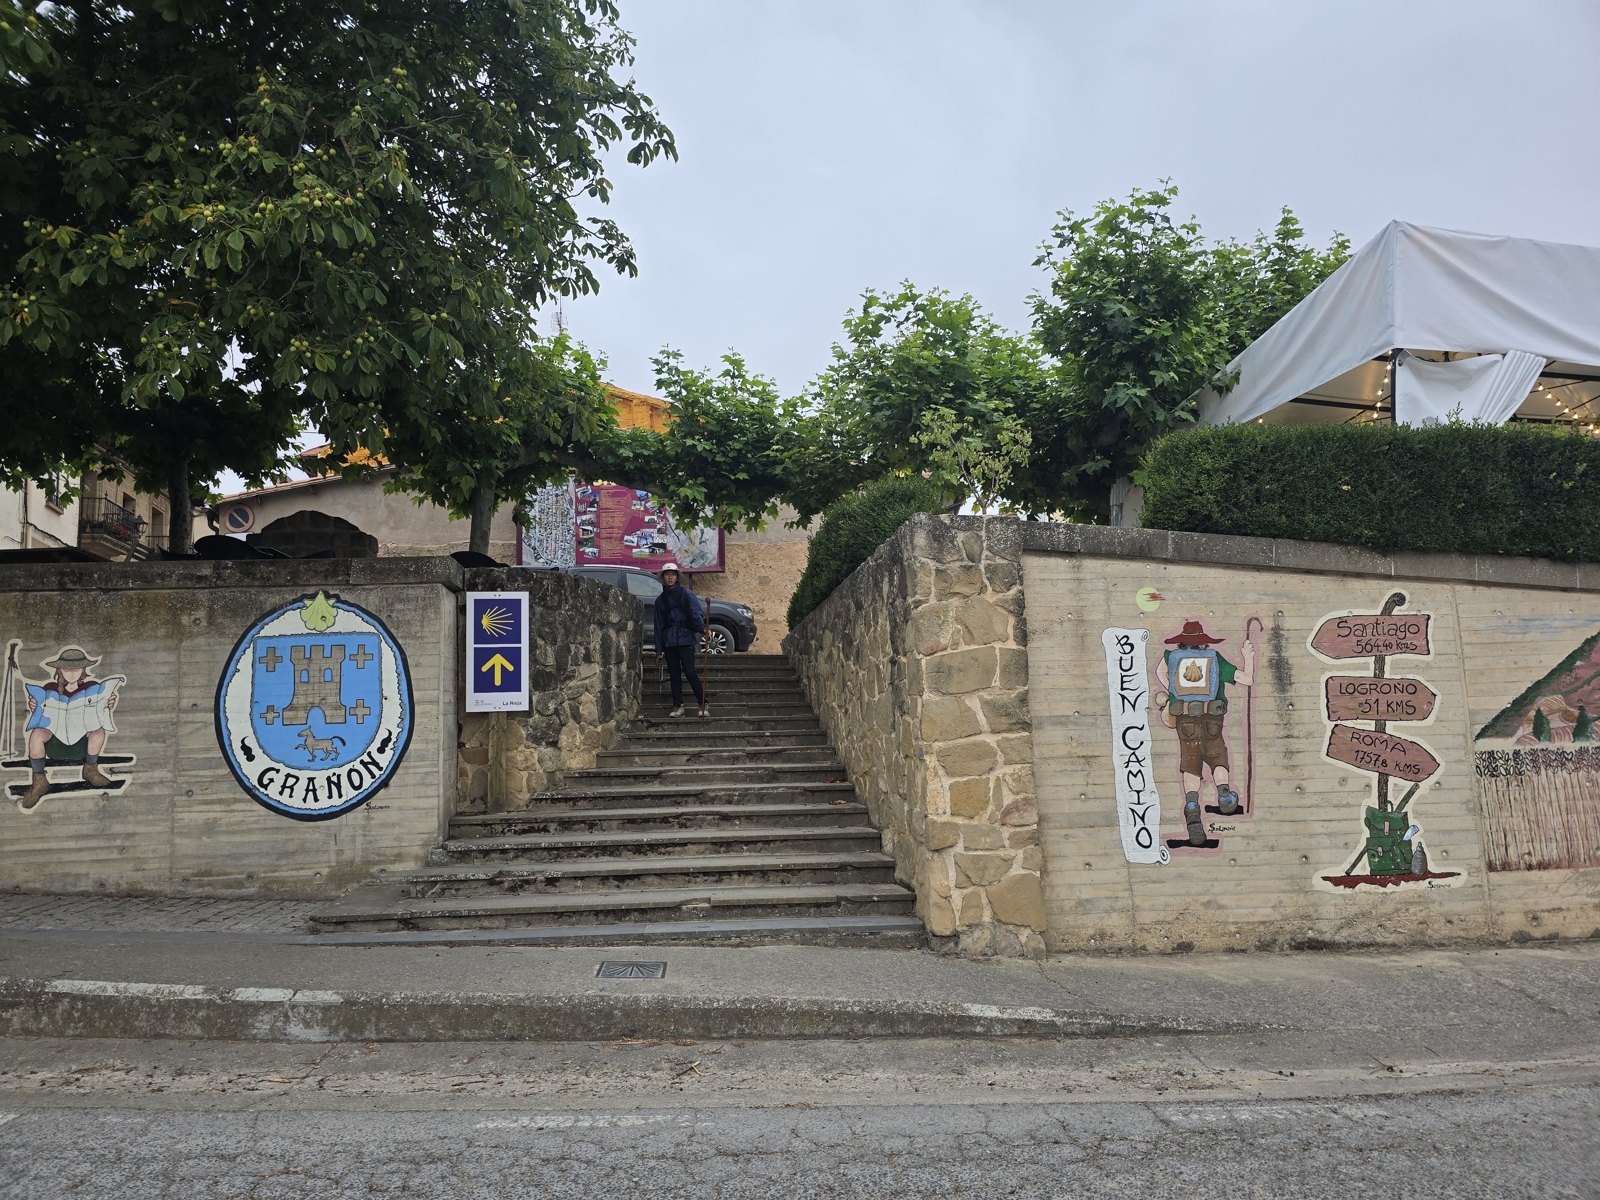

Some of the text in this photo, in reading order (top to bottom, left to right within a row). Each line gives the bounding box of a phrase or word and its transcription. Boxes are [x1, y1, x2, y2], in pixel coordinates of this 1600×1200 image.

[1336, 618, 1420, 640] Santiago
[1339, 680, 1418, 696] LOGROÑO
[1360, 698, 1417, 716] 51 KMS
[1115, 634, 1154, 849] BUEN CAMINO
[1350, 731, 1407, 756] ROMA
[1394, 761, 1421, 775] KMS
